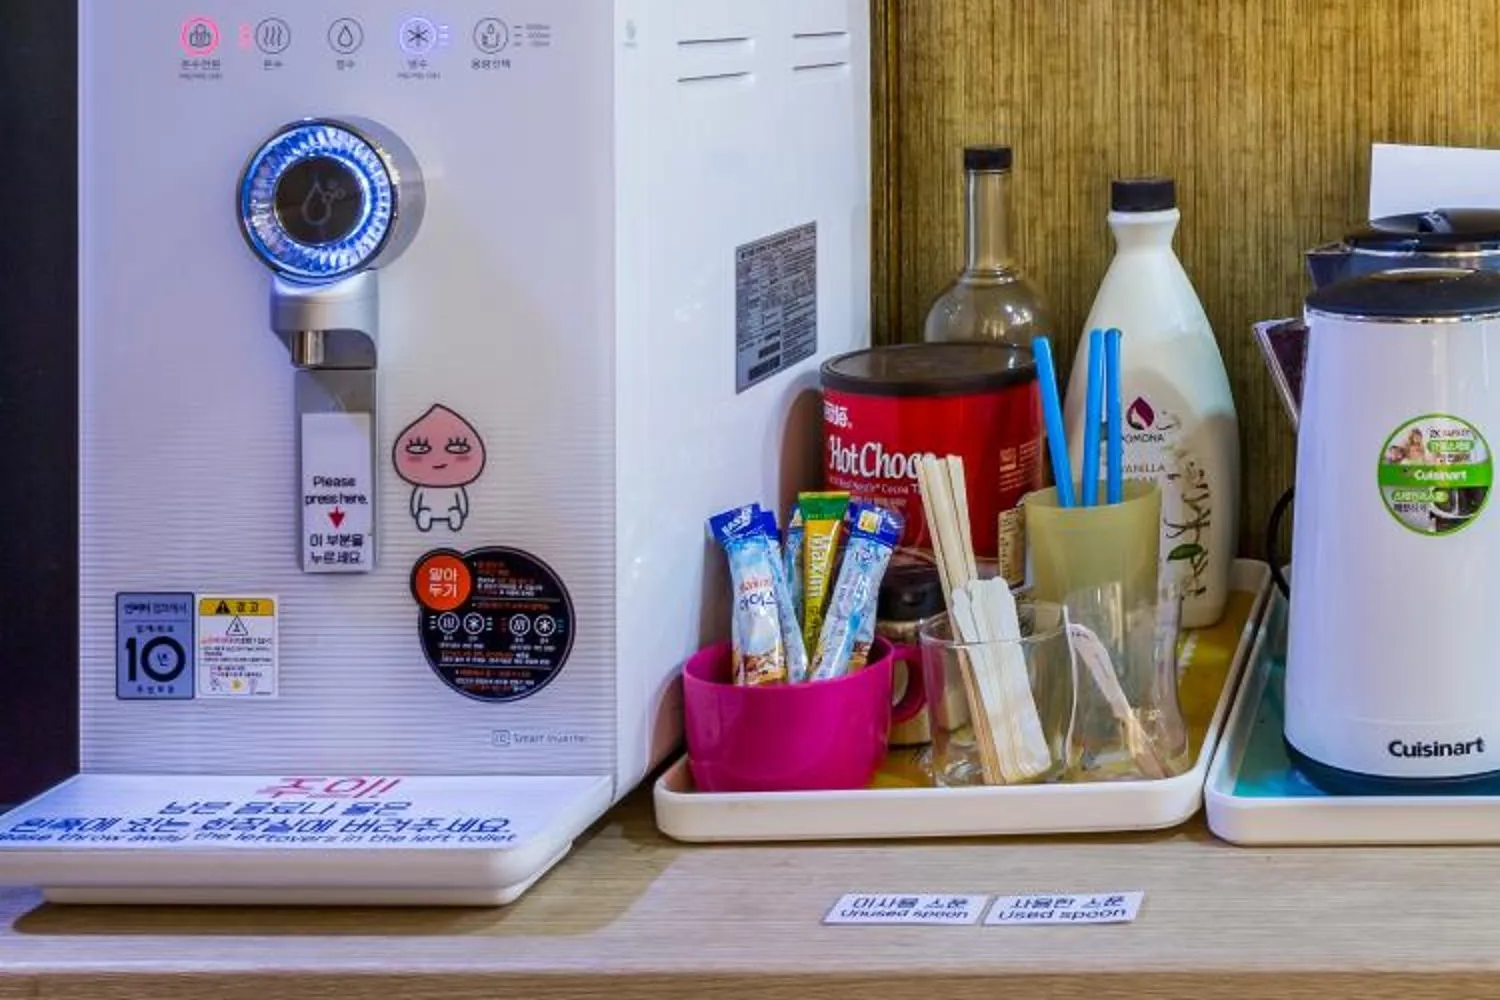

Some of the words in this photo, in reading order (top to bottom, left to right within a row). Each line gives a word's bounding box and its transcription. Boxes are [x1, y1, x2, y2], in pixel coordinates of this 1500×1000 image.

[1122, 462, 1167, 473] ANILLA
[313, 475, 357, 487] Please
[310, 533, 323, 547] 이
[429, 584, 458, 598] 두기
[1388, 737, 1486, 759] Cuisinart
[193, 832, 233, 842] the
[344, 833, 365, 843] in
[368, 833, 409, 843] the
[841, 908, 909, 919] Unused
[913, 909, 969, 920] spoon
[999, 909, 1053, 920] Used
[1058, 908, 1127, 921] spoon
